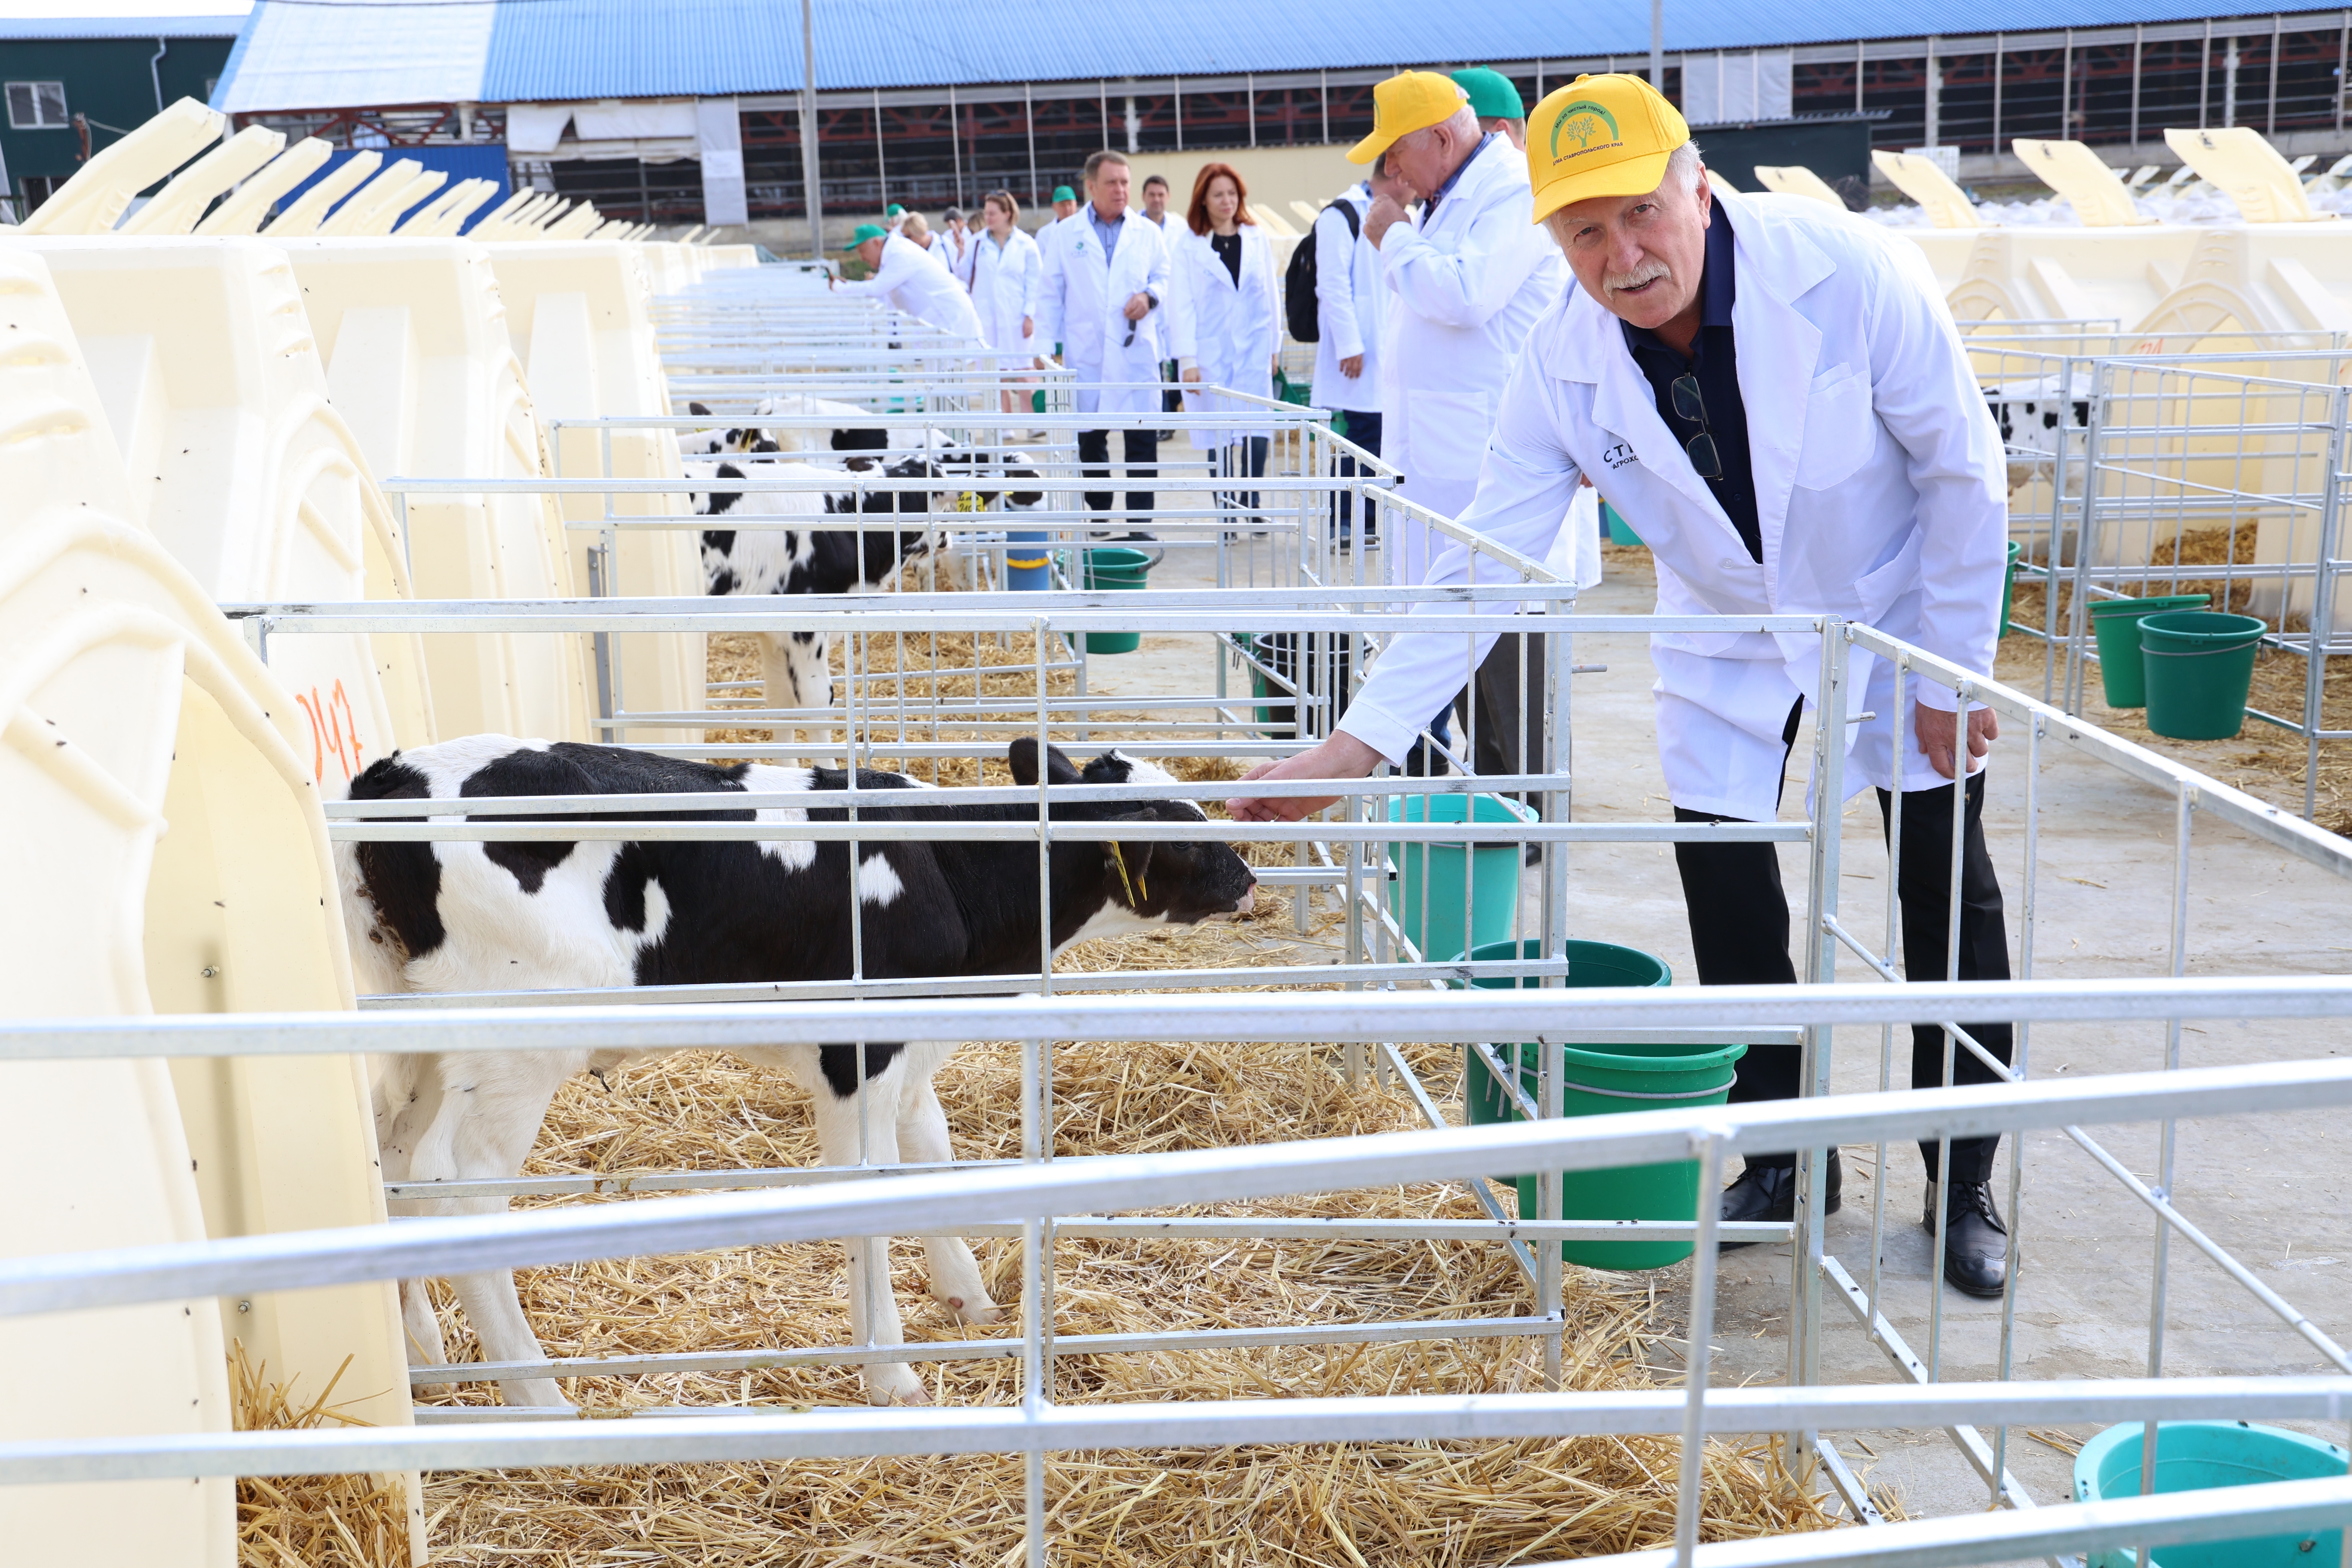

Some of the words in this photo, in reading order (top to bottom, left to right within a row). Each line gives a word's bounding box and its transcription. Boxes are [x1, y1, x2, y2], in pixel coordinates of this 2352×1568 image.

[1555, 119, 1562, 129] Мы
[1568, 105, 1586, 114] чистый
[1588, 106, 1606, 115] город!
[1553, 158, 1563, 167] ДУМА
[1563, 144, 1610, 160] СТАВРОПОЛЬСКОГО
